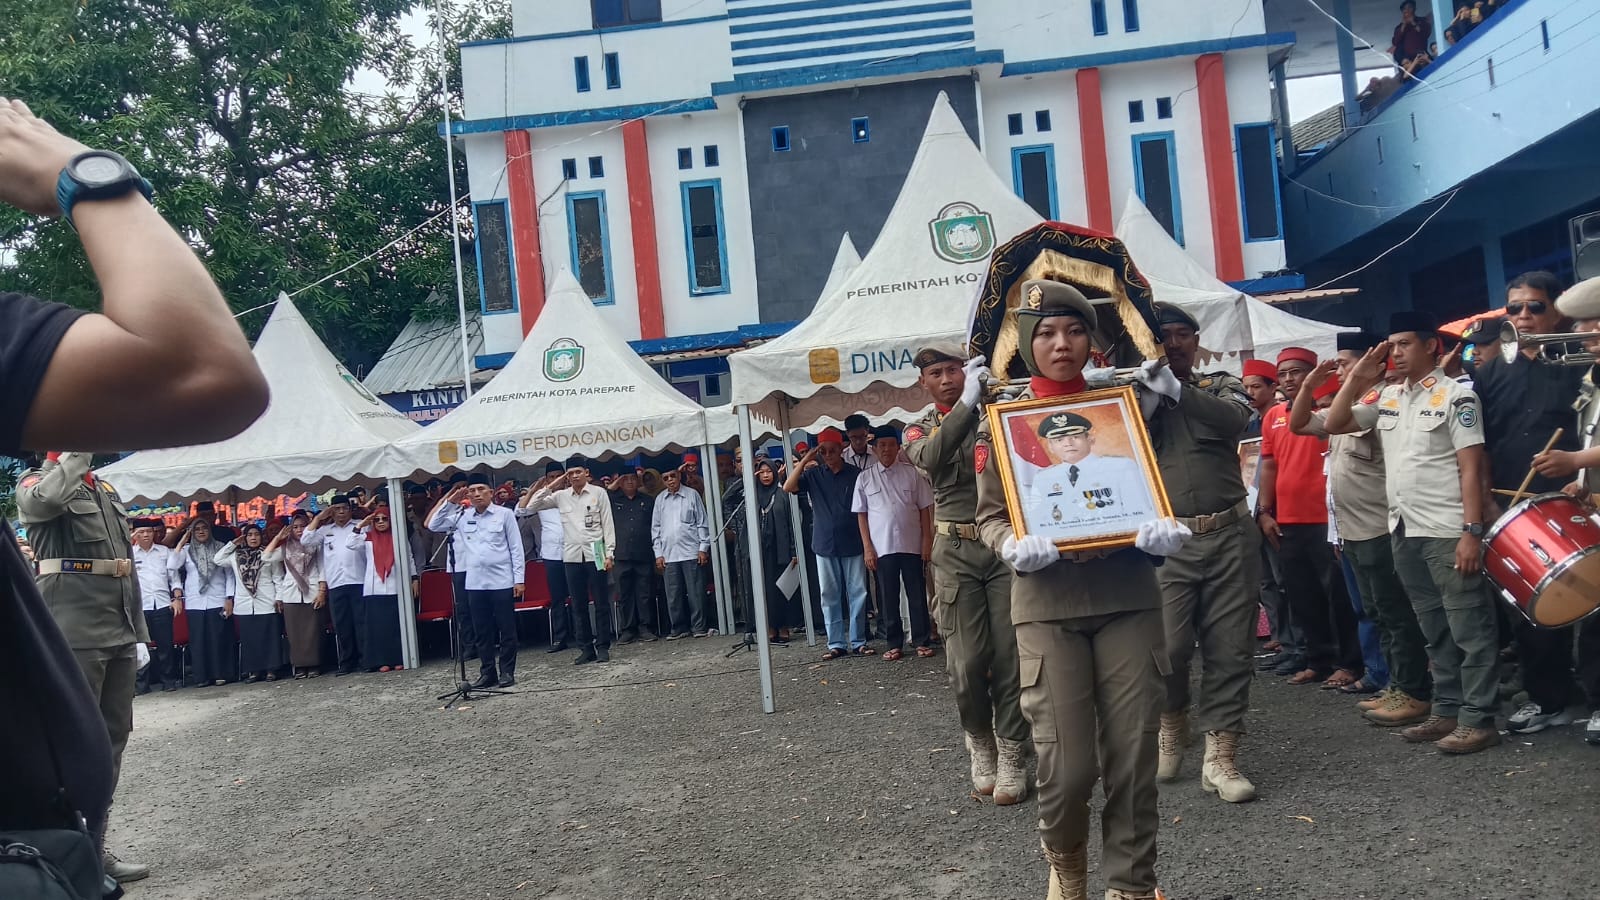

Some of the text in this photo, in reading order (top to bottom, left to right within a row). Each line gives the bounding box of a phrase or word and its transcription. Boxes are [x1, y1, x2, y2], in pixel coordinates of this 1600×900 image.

[847, 276, 950, 300] PEMERINTAH
[851, 347, 922, 375] DINA
[479, 384, 636, 405] PEMERINTAH KOTA PAREPARE
[464, 424, 655, 459] DINAS PERDAGANGAN
